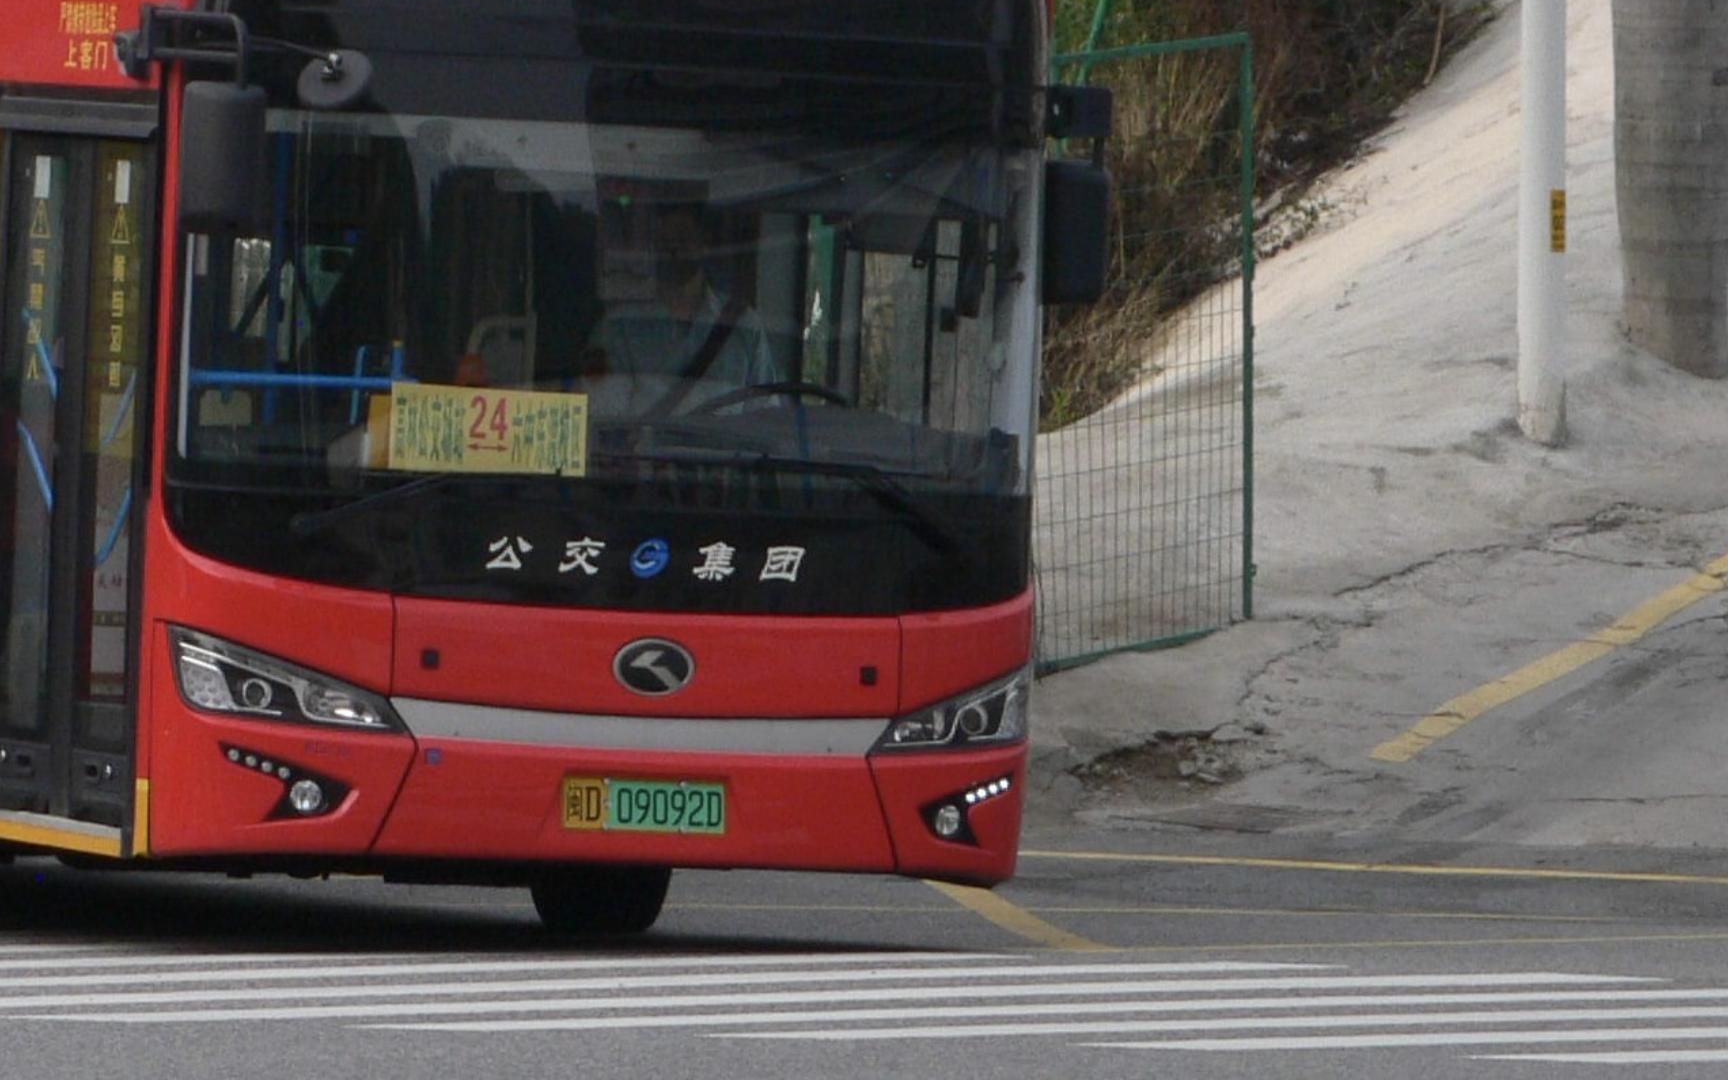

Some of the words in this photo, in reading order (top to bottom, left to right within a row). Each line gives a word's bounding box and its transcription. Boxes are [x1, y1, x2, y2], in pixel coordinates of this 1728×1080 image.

[63, 39, 108, 71] 上客门
[469, 395, 509, 440] 24
[616, 788, 723, 828] 09092D
